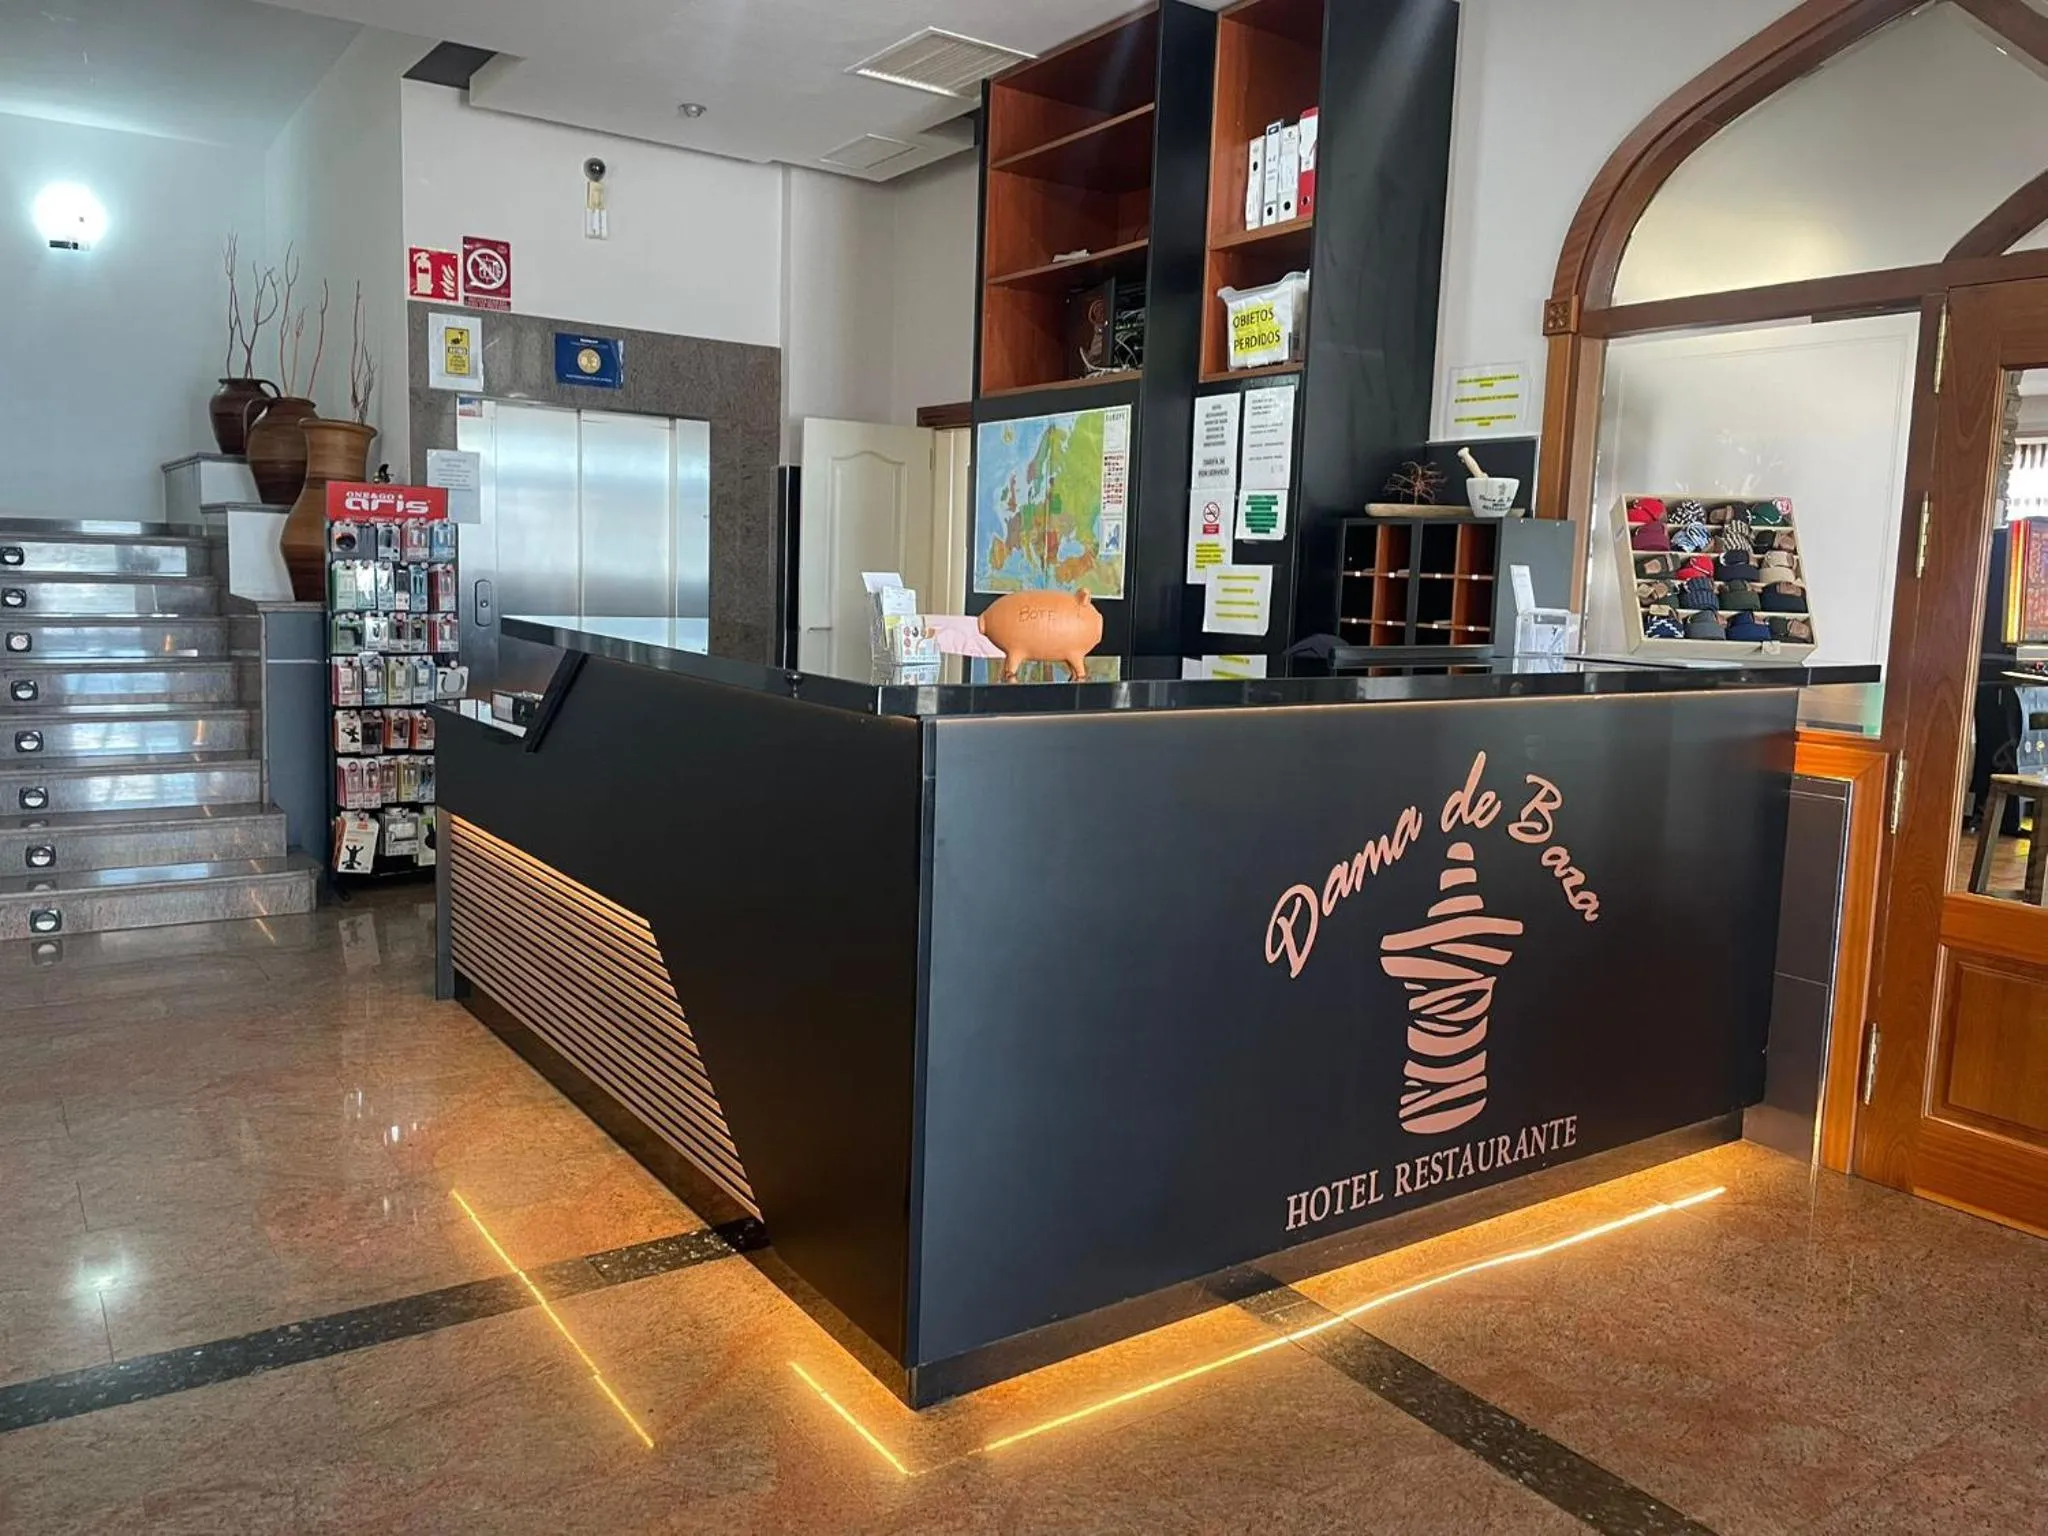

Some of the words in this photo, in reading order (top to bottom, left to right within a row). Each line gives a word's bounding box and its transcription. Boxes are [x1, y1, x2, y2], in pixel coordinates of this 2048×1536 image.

[1233, 307, 1275, 329] OBJETOS
[1233, 329, 1281, 351] PERDIDOS
[1264, 805, 1423, 979] Dama
[1440, 750, 1502, 833] de
[1507, 773, 1600, 922] Baza
[1285, 1169, 1384, 1232] HOTEL
[1394, 1115, 1578, 1197] RESTAURANTE
